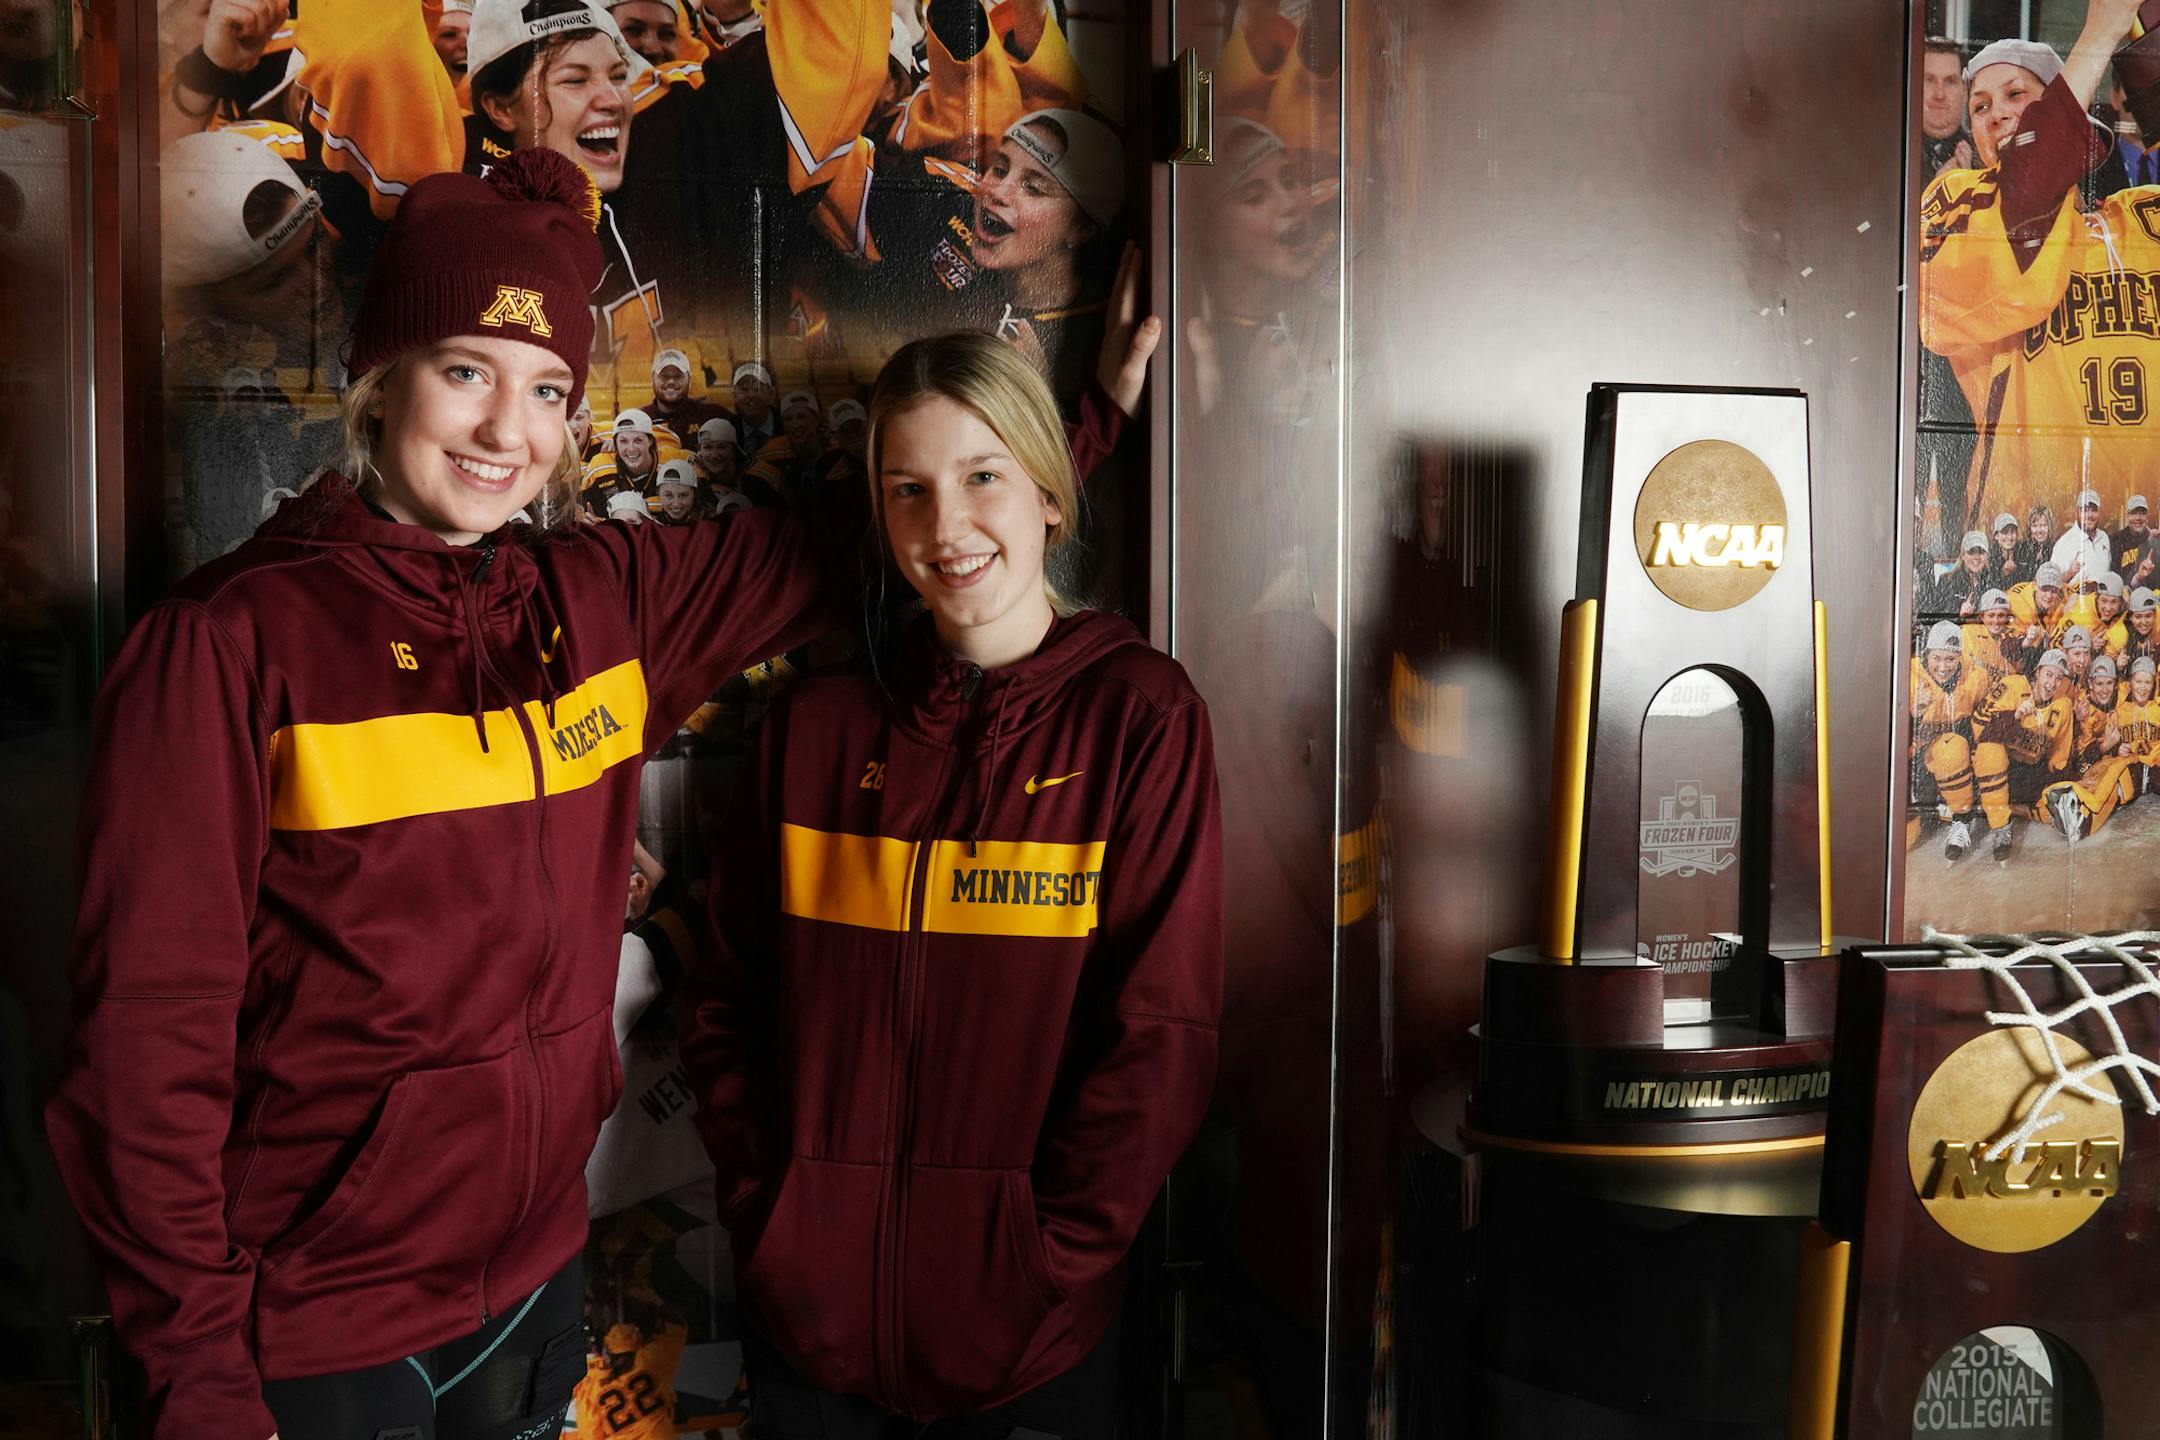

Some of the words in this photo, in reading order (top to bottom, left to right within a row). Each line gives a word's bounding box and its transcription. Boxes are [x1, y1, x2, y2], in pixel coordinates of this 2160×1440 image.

[482, 136, 512, 158] WC
[480, 285, 552, 338] M
[2079, 356, 2149, 426] 19
[1647, 521, 1785, 571] NCAA
[390, 641, 419, 670] 16
[1670, 684, 1712, 704] 2016
[860, 761, 886, 790] 26
[1644, 827, 1696, 844] FROZEN
[1699, 825, 1733, 841] FOUR
[1653, 943, 1679, 962] ICE
[1681, 940, 1739, 960] HOCKEY
[1656, 933, 1689, 943] WOMEN'S
[1662, 959, 1731, 975] AMPIONSHIP
[1604, 1079, 1723, 1109] NATIONAL
[1729, 1071, 1832, 1106] CHAMPIO
[1931, 1136, 2120, 1199] NCAA
[1950, 1344, 2019, 1369] 2015
[1925, 1366, 2043, 1400] NATIONAL
[599, 1373, 665, 1433] 22
[1912, 1396, 2054, 1432] COLLEGIATE
